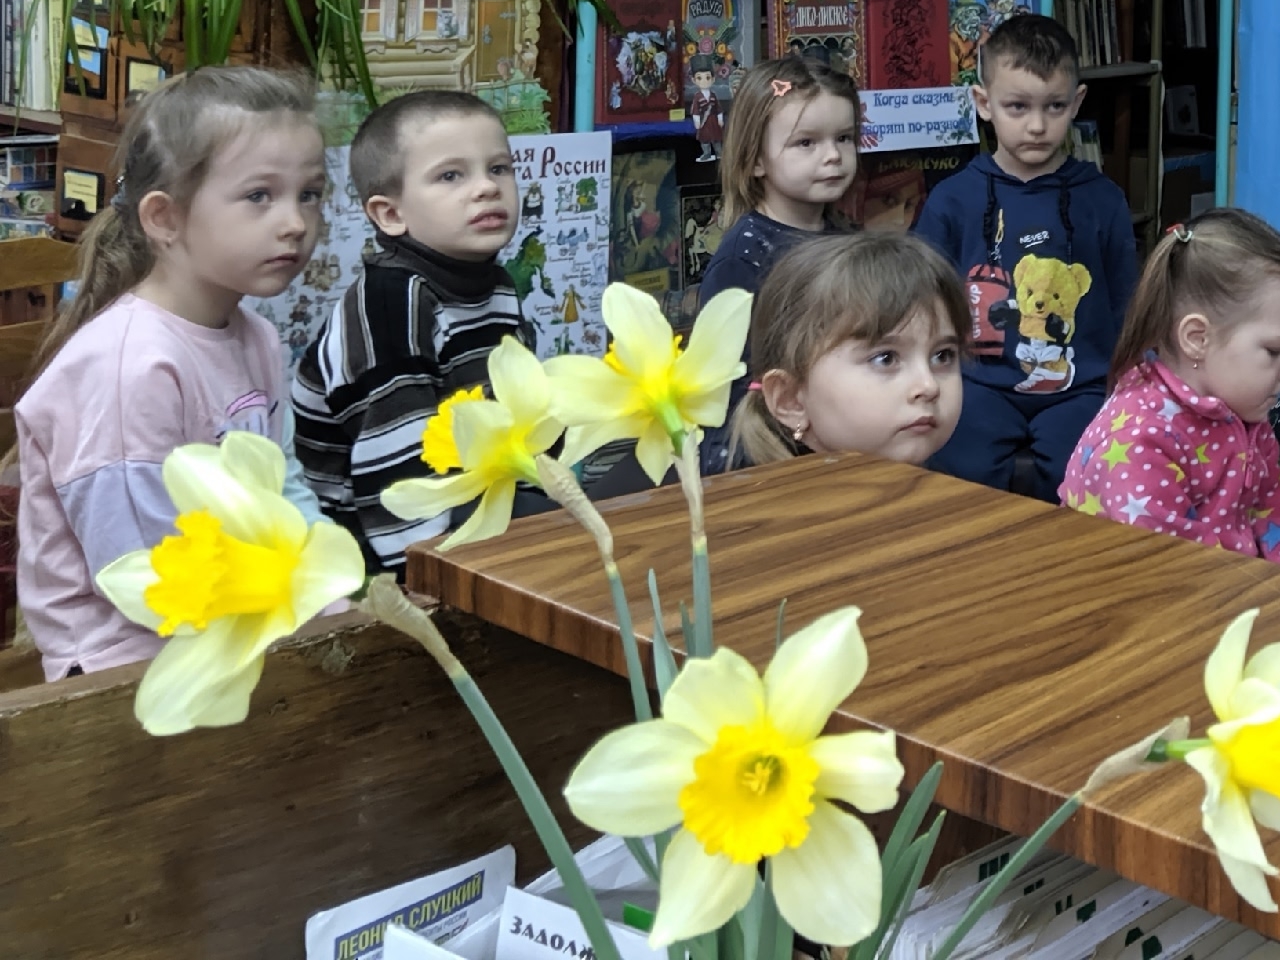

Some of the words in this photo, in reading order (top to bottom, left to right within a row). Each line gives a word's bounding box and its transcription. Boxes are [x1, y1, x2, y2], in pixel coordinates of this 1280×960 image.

[689, 0, 723, 18] РАДУГА
[873, 92, 909, 108] Когда
[1019, 230, 1050, 244] NEVER
[408, 873, 482, 929] СЛУЦКИЙ
